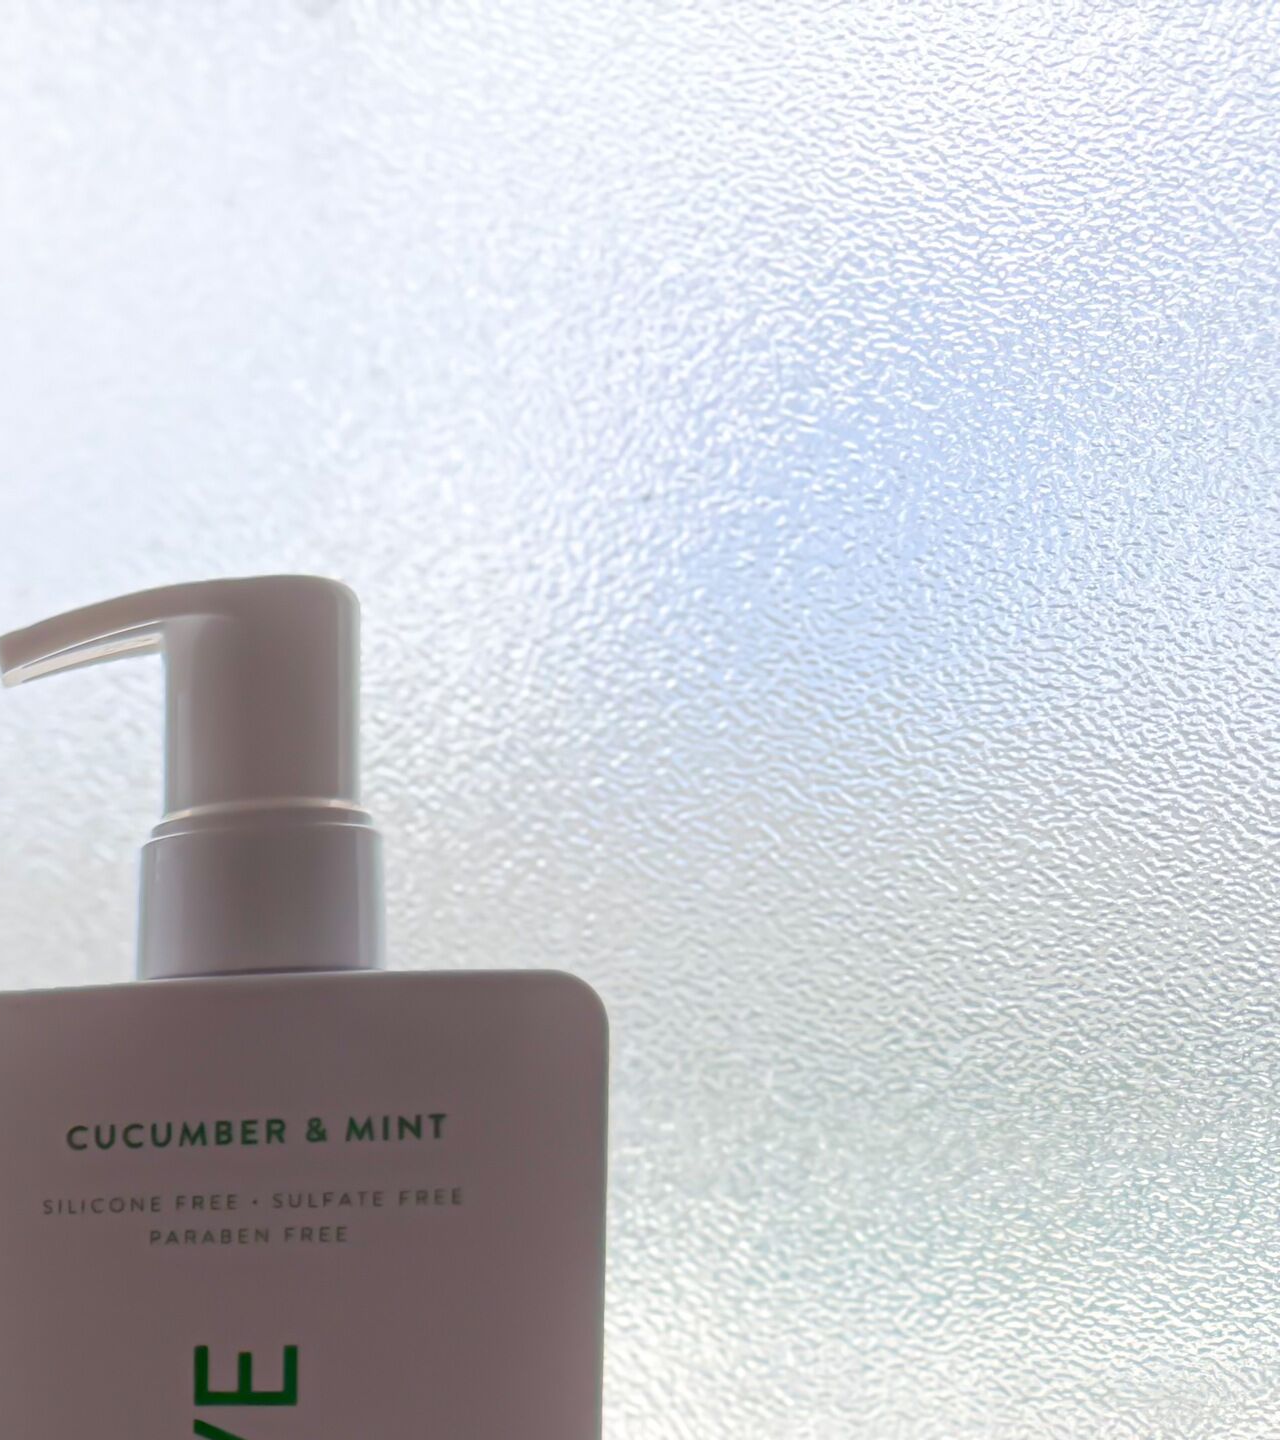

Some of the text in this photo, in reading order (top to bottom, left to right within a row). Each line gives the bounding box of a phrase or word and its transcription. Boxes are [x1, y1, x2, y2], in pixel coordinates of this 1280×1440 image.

[66, 1112, 447, 1151] CUCUMBER & MINT
[42, 1187, 463, 1216] SILICONE FREE SULFATE FREE
[149, 1225, 347, 1246] PARABEN FREE
